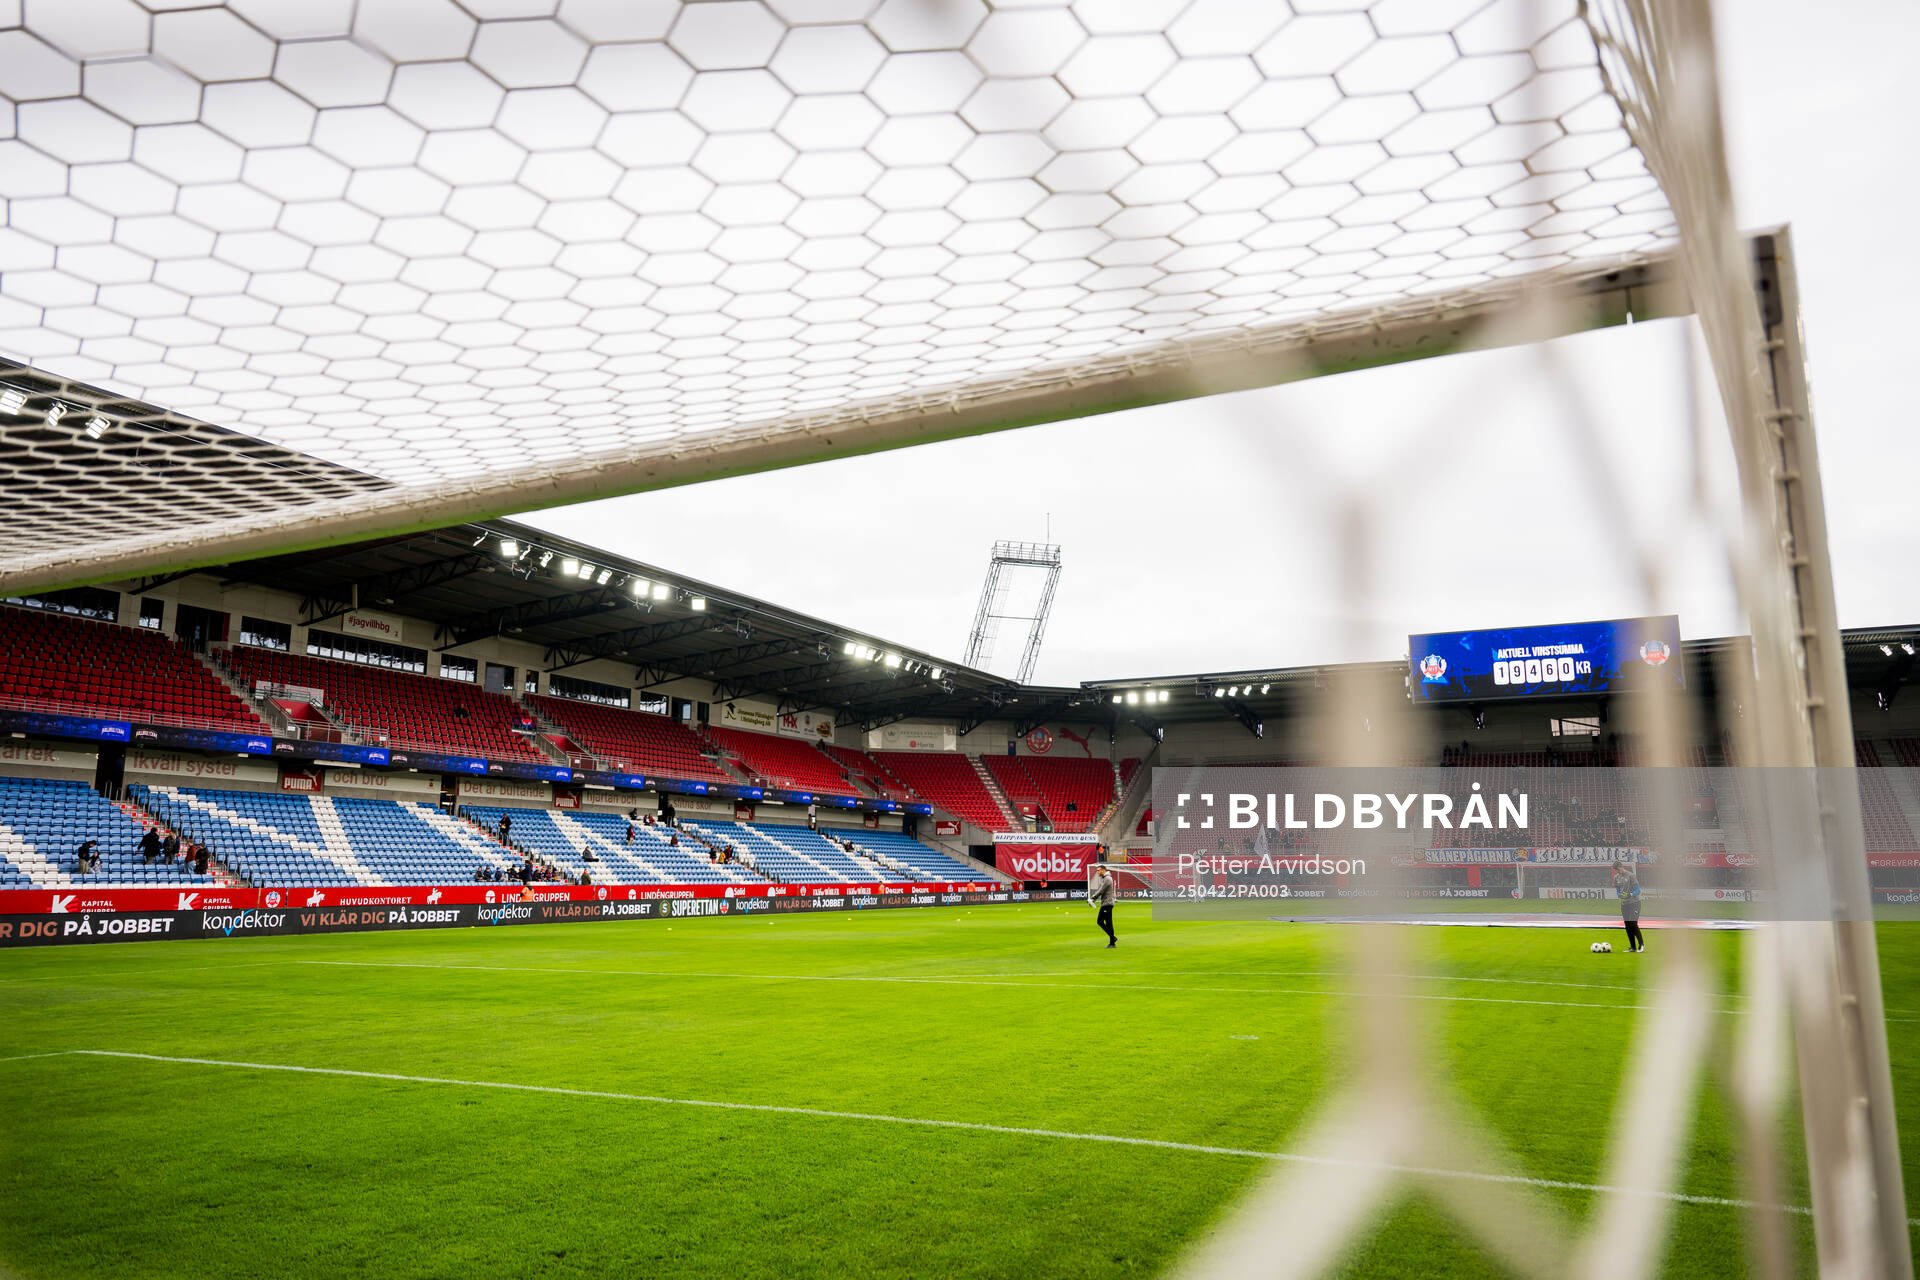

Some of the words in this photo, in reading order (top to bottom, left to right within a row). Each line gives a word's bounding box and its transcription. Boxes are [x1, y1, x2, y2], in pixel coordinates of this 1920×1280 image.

[1498, 647, 1531, 659] AKTUELL
[1532, 644, 1584, 656] VINSTSUMMA
[1575, 661, 1591, 674] KR
[133, 751, 181, 772] ikväll
[185, 759, 239, 776] syster
[284, 777, 313, 790] PUMA
[333, 771, 359, 784] och
[362, 773, 389, 786] bror
[463, 780, 483, 793] Det
[500, 782, 545, 798] bultande
[1424, 847, 1511, 862] SKÅNEPÅGARNA
[1012, 852, 1082, 873] vobbiz
[640, 889, 694, 900] LINDÉNGRUPPEN
[734, 887, 746, 896] Solid
[775, 886, 786, 895] Solid
[1138, 888, 1148, 898] PÅ
[1148, 890, 1178, 898] JOBBET
[1293, 889, 1326, 898] JOBBET
[1439, 887, 1453, 897] PÅ
[1453, 889, 1489, 897] JOBBET
[1547, 888, 1606, 900] tillmobil
[340, 896, 412, 905] HUVUDKONTORET
[501, 892, 570, 903] LINDGRUPPEN
[735, 898, 770, 910] kondektor
[775, 901, 782, 909] VI
[783, 899, 799, 909] KLÄR
[800, 900, 812, 908] DIG
[812, 897, 821, 908] PÅ
[821, 898, 845, 908] JOBBET
[851, 896, 878, 906] kondektor
[910, 894, 918, 904] PÅ
[918, 895, 936, 904] JOBBET
[478, 904, 533, 920] kondektor
[542, 906, 553, 917] VI
[555, 903, 582, 917] KLÄR
[583, 905, 601, 916] DIG
[602, 901, 616, 915] PÅ
[616, 903, 652, 914] JOBBET
[671, 899, 719, 917] SUPERETTAN
[202, 910, 286, 930] kondektor
[301, 913, 316, 927] VI
[319, 909, 358, 926] KLÄR
[361, 911, 385, 924] DIG
[388, 906, 408, 923] PÅ
[410, 910, 461, 923] JOBBET
[19, 921, 58, 937] DIG
[63, 914, 93, 936] PÅ
[97, 917, 174, 935] JOBBET
